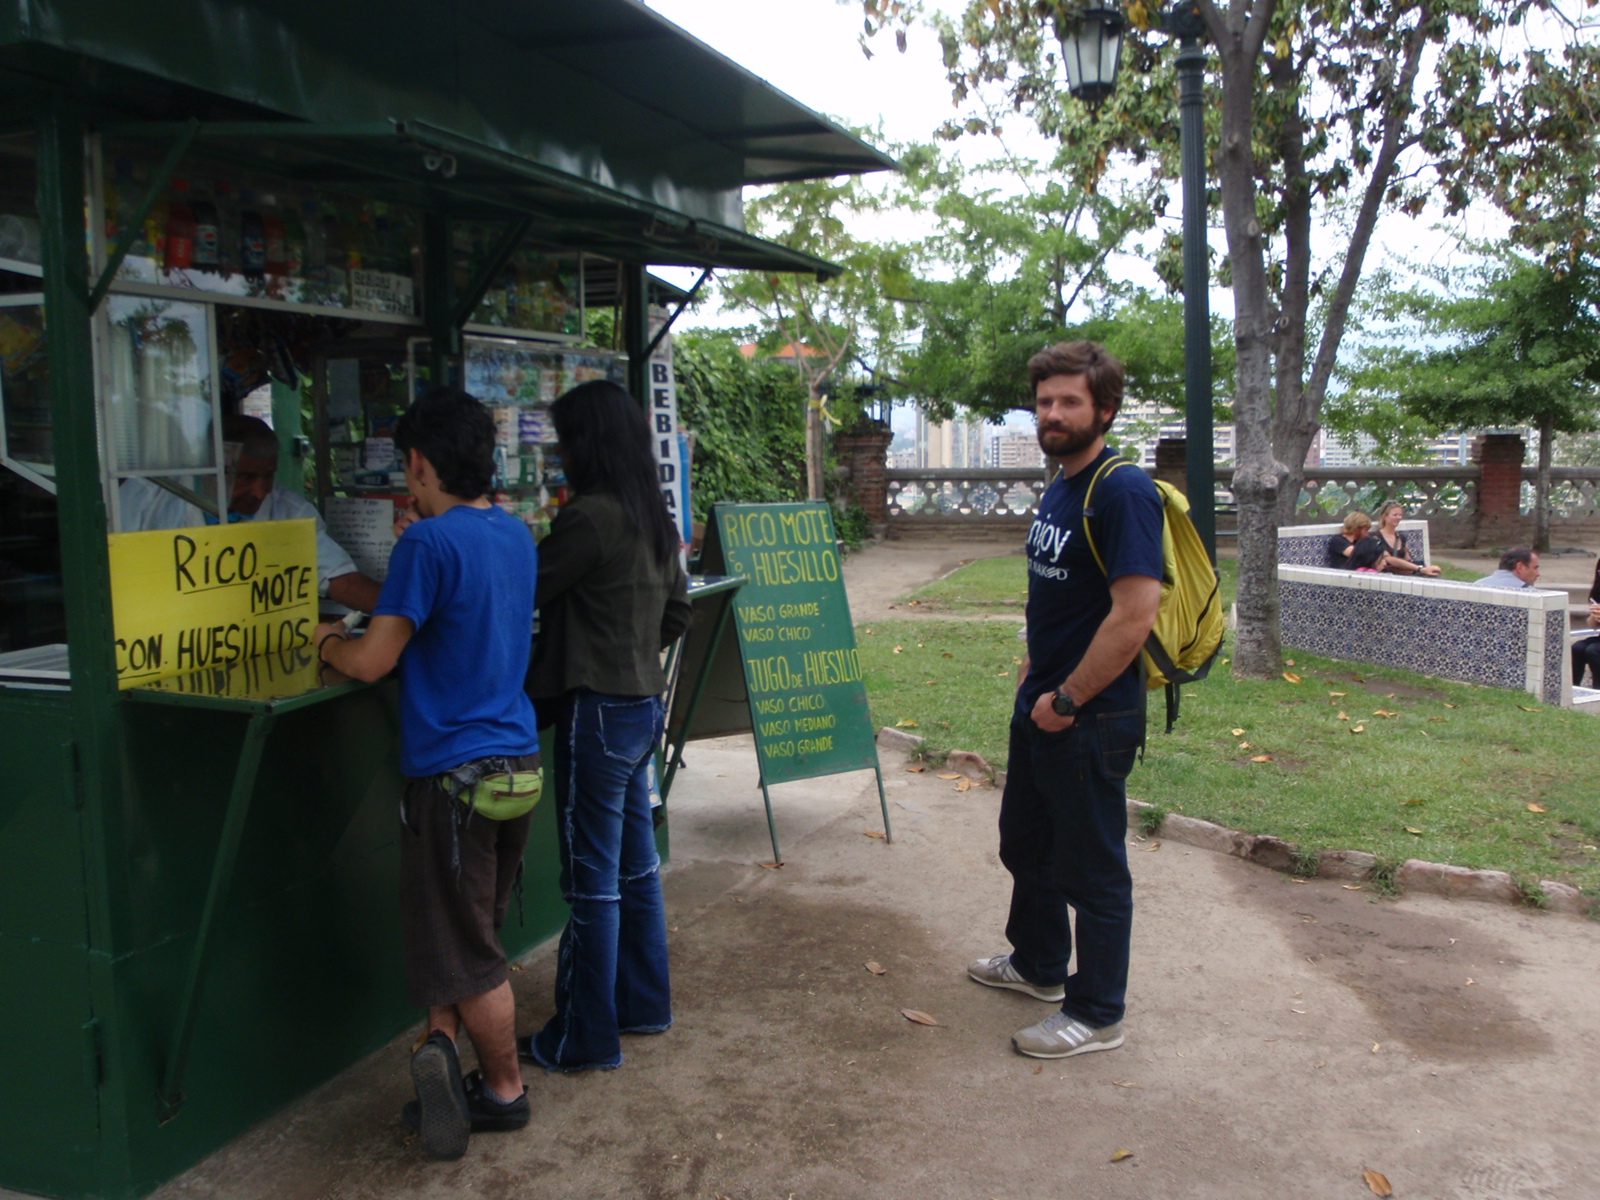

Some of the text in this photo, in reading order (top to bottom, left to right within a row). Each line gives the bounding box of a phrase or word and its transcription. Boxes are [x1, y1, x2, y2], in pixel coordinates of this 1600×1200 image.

[652, 363, 676, 520] BEBIDA
[723, 510, 833, 547] RICO MOTE
[1027, 513, 1072, 563] njoy
[752, 550, 838, 586] HUESILLO
[251, 565, 312, 613] MOTE
[738, 602, 820, 624] VASO GRANDE
[742, 626, 811, 642] VASO CHICO
[748, 649, 863, 692] JUGO DE HUESILLO
[755, 694, 825, 715] VASO CHICO
[760, 715, 836, 737] VASO MEDIANO
[764, 736, 833, 758] VASO GRANDE
